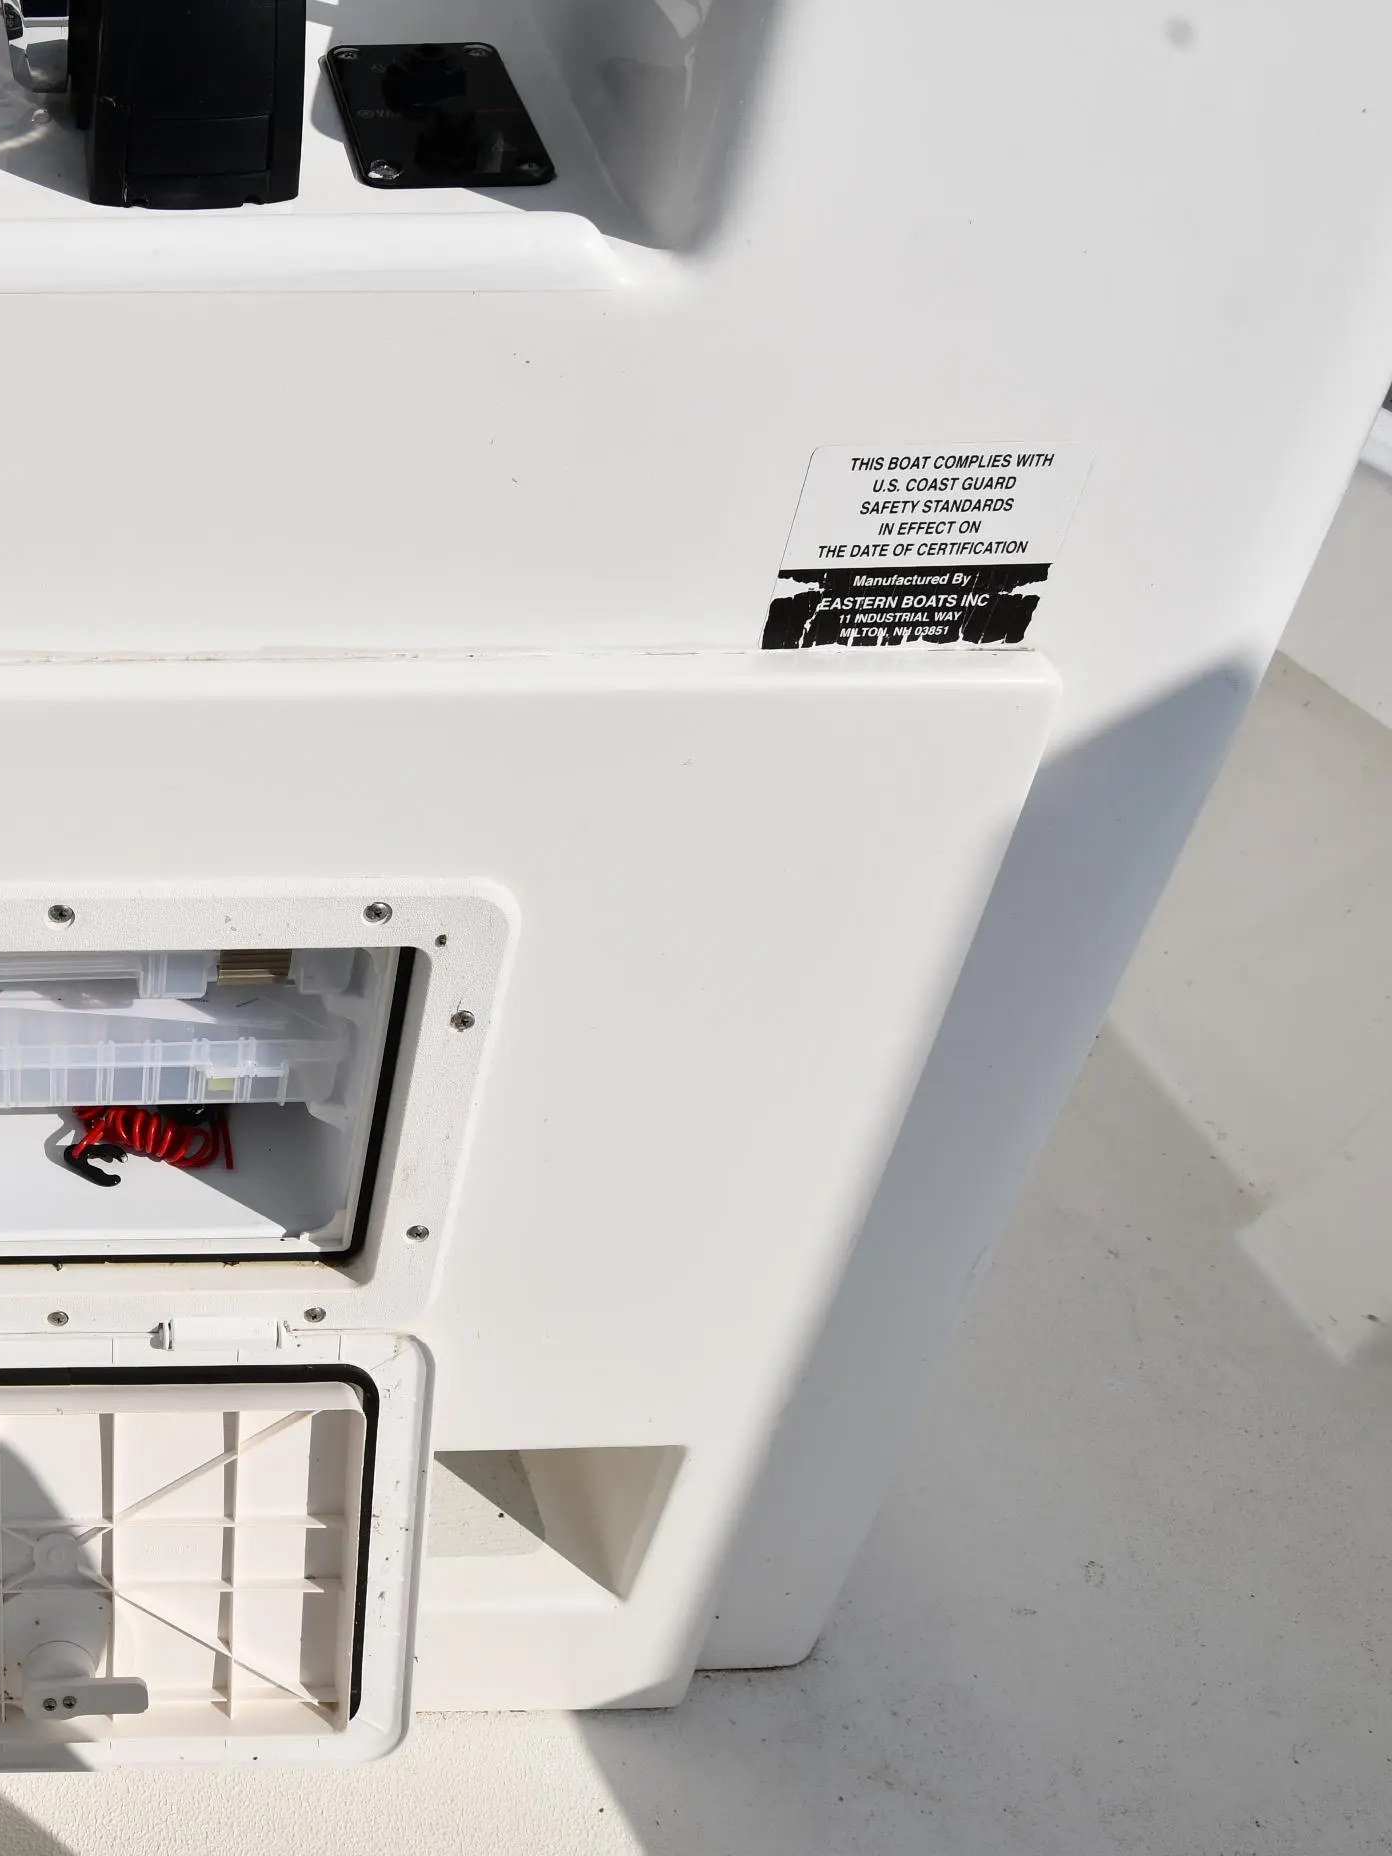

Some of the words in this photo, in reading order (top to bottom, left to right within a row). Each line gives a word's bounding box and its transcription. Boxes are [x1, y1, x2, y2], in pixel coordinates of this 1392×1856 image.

[850, 456, 884, 472] THIS
[888, 455, 930, 470] BOAT
[932, 454, 1014, 470] COMPLIES
[1015, 453, 1055, 468] WITH
[872, 479, 902, 493] U.S.
[905, 478, 960, 492] COAST
[961, 476, 1017, 490] GUARD
[859, 500, 920, 515] SAFETY
[921, 498, 1015, 513] STANDARDS
[878, 522, 895, 536] IN
[897, 521, 956, 535] EFFECT
[958, 520, 982, 534] ON
[817, 545, 848, 559] THE
[849, 544, 891, 558] DATE
[892, 543, 914, 556] OF
[915, 541, 1029, 556] CERTIFICATION
[853, 573, 950, 587] Manufactured
[952, 573, 971, 586] By
[818, 596, 898, 610] EASTERN
[900, 595, 958, 608] BOATS
[960, 593, 990, 607] INC
[838, 615, 850, 624] 11
[853, 612, 931, 623] INDUSTRIAL
[933, 611, 963, 622] WAY
[914, 625, 950, 636] 03851
